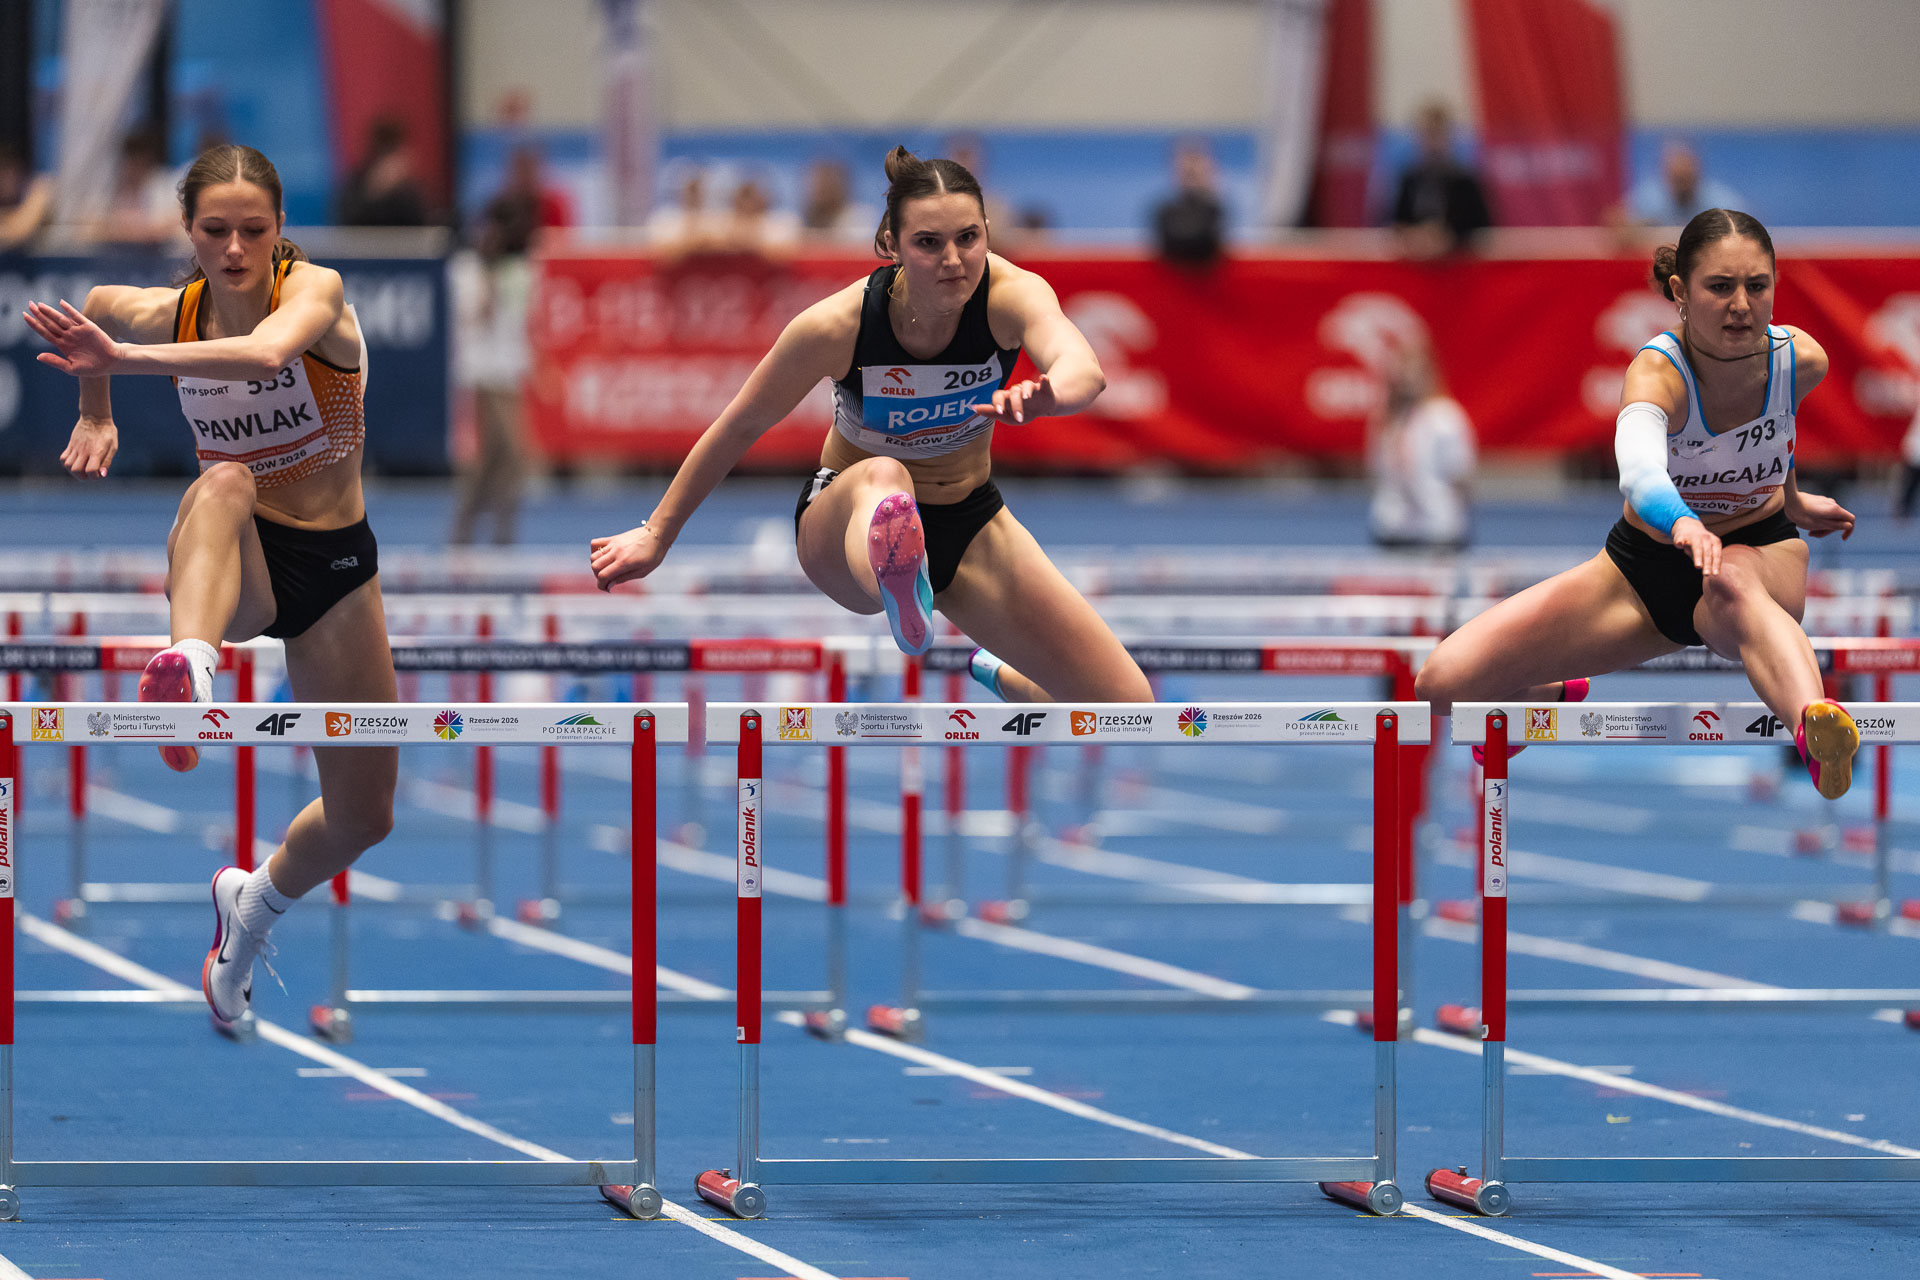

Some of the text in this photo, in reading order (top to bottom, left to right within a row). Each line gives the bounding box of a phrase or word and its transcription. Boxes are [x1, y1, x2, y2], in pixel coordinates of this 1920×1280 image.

[944, 366, 992, 390] 208
[182, 386, 229, 396] TVP SPORT
[881, 386, 914, 396] ORLEN
[888, 395, 978, 429] ROJEK
[194, 402, 313, 442] PAWLAK
[1736, 419, 1776, 452] 793
[885, 436, 943, 447] RZESZÓW
[280, 450, 306, 466] 2026
[1687, 501, 1730, 510] ESZÓW
[330, 556, 358, 570] esa
[113, 714, 161, 722] Ministerstwo
[354, 715, 408, 728] rzeszów
[1100, 714, 1152, 726] rzeszów
[1606, 714, 1652, 722] Ministerstwo
[1853, 718, 1896, 728] eszów
[113, 722, 137, 732] Sportu
[144, 722, 176, 732] Turystyki
[256, 712, 302, 735] 4F
[860, 722, 884, 731] Sportu
[890, 722, 923, 731] Turystyki
[1002, 712, 1046, 735] 4F
[1606, 723, 1628, 732] Sportu
[1636, 723, 1667, 732] Turystyki
[34, 729, 62, 739] PZLA
[378, 728, 408, 736] innowacji
[542, 726, 616, 734] PODKARPACKIE
[782, 729, 810, 738] PZLA
[1123, 726, 1152, 734] innowacji
[1527, 730, 1556, 740] PZLA
[1866, 730, 1896, 738] innowacji
[198, 732, 233, 740] ORLEN
[944, 732, 979, 740] ORLEN
[1689, 732, 1723, 740] ORLEN
[742, 806, 758, 868] polanik
[1489, 806, 1504, 868] polanik
